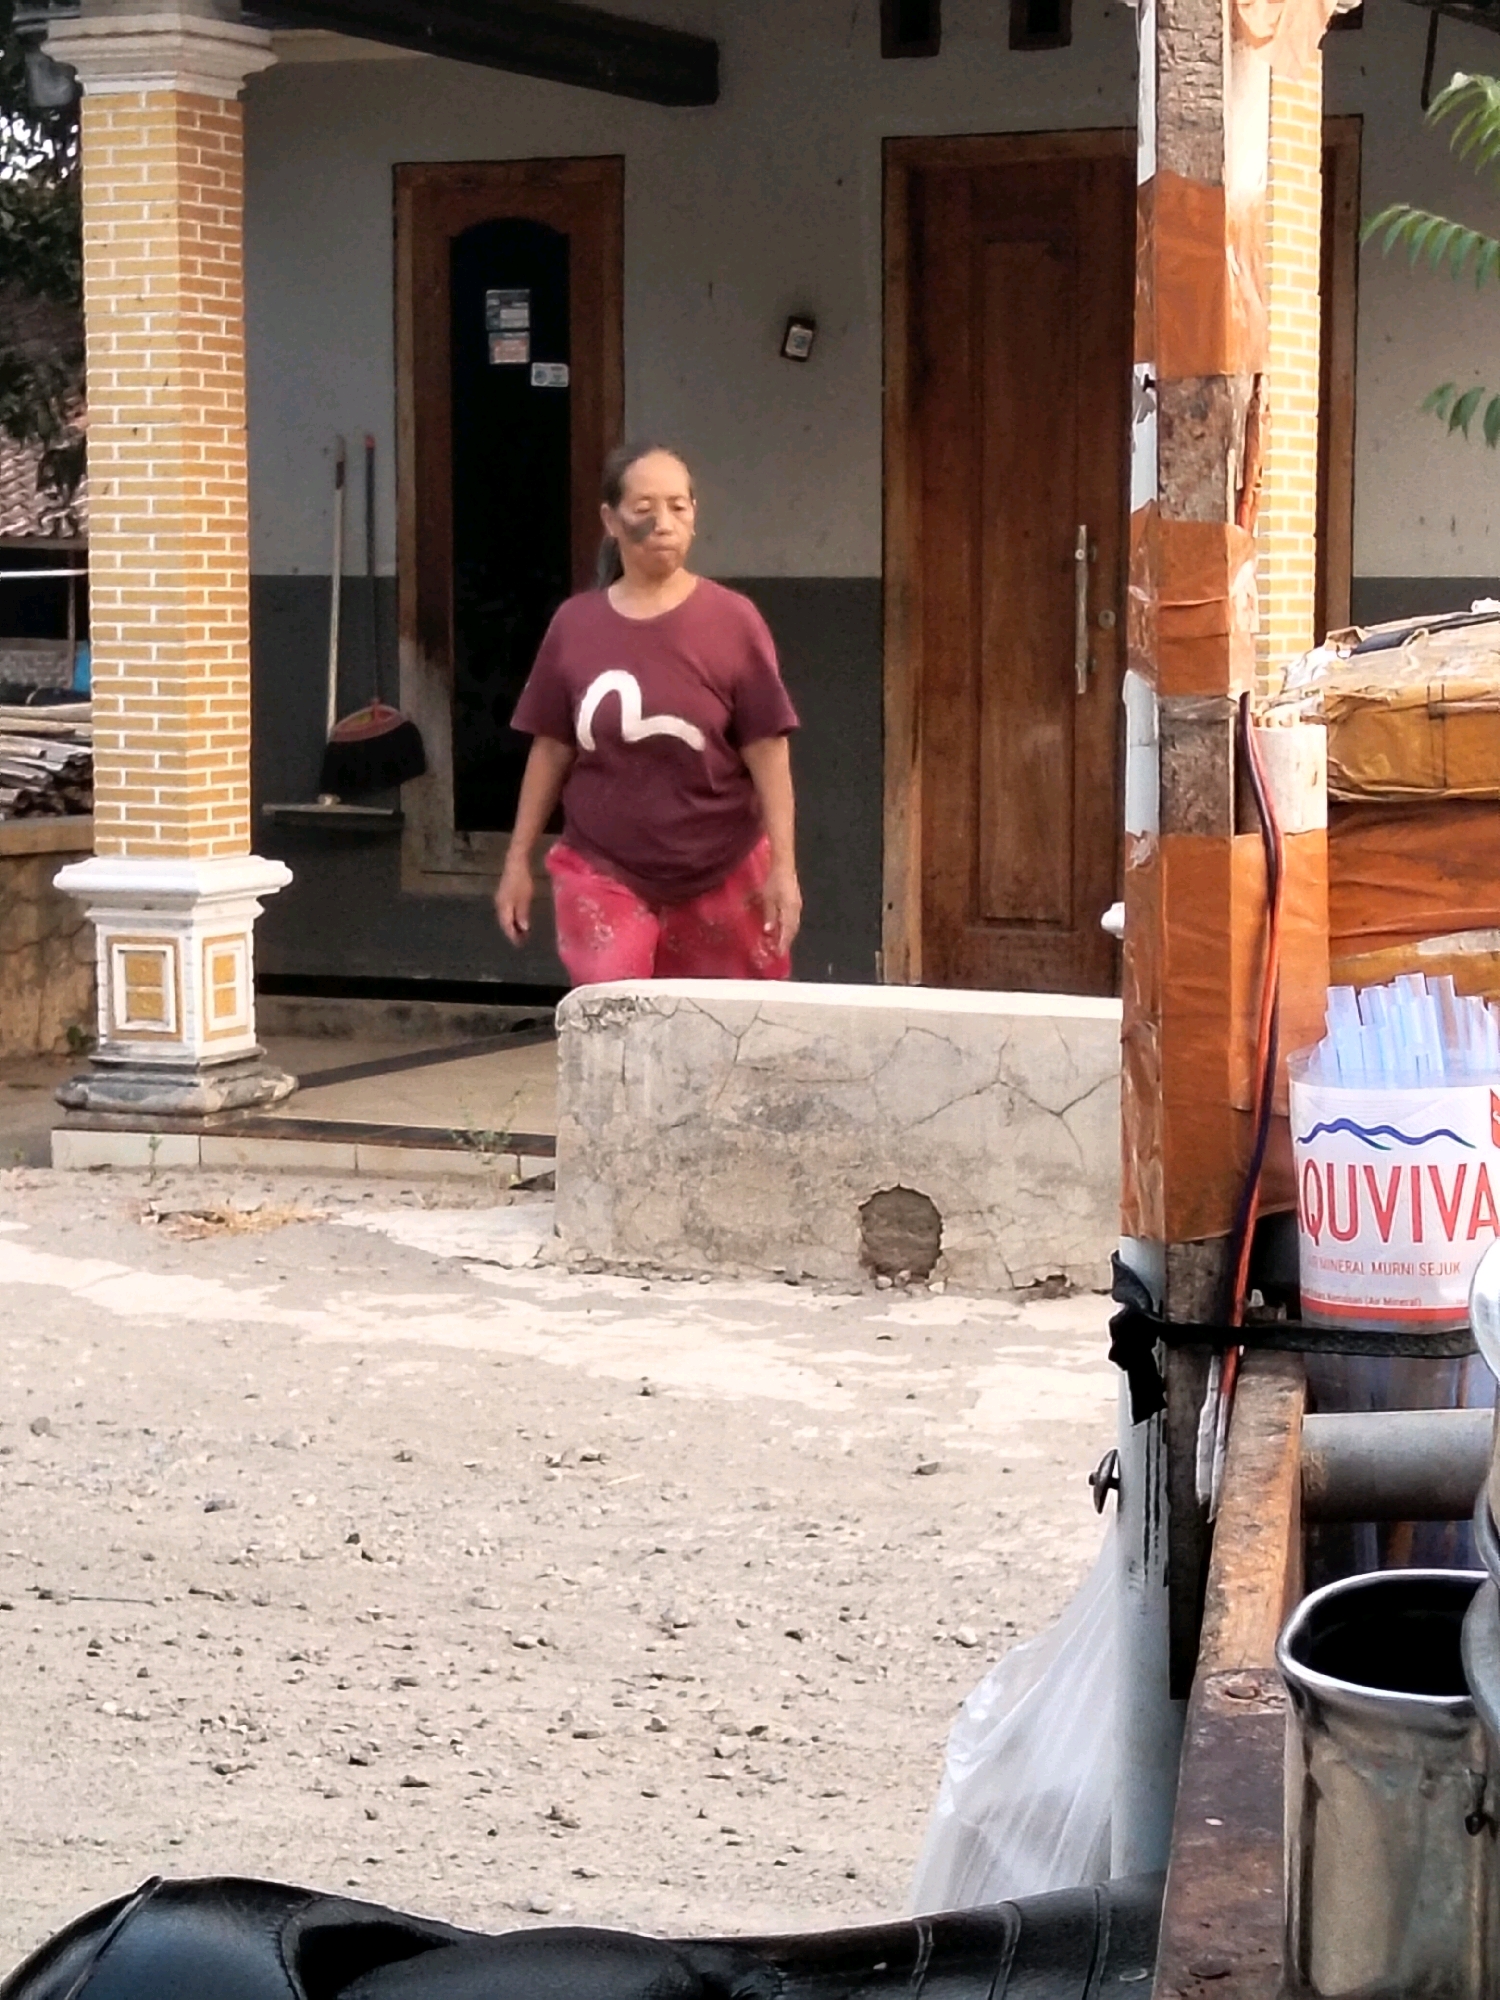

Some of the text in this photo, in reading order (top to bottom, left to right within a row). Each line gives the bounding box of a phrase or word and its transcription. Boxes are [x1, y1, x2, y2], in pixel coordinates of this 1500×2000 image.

[1300, 1158, 1500, 1246] QUVIVA
[1371, 1261, 1415, 1276] MURNI
[1419, 1261, 1461, 1277] SEJUK
